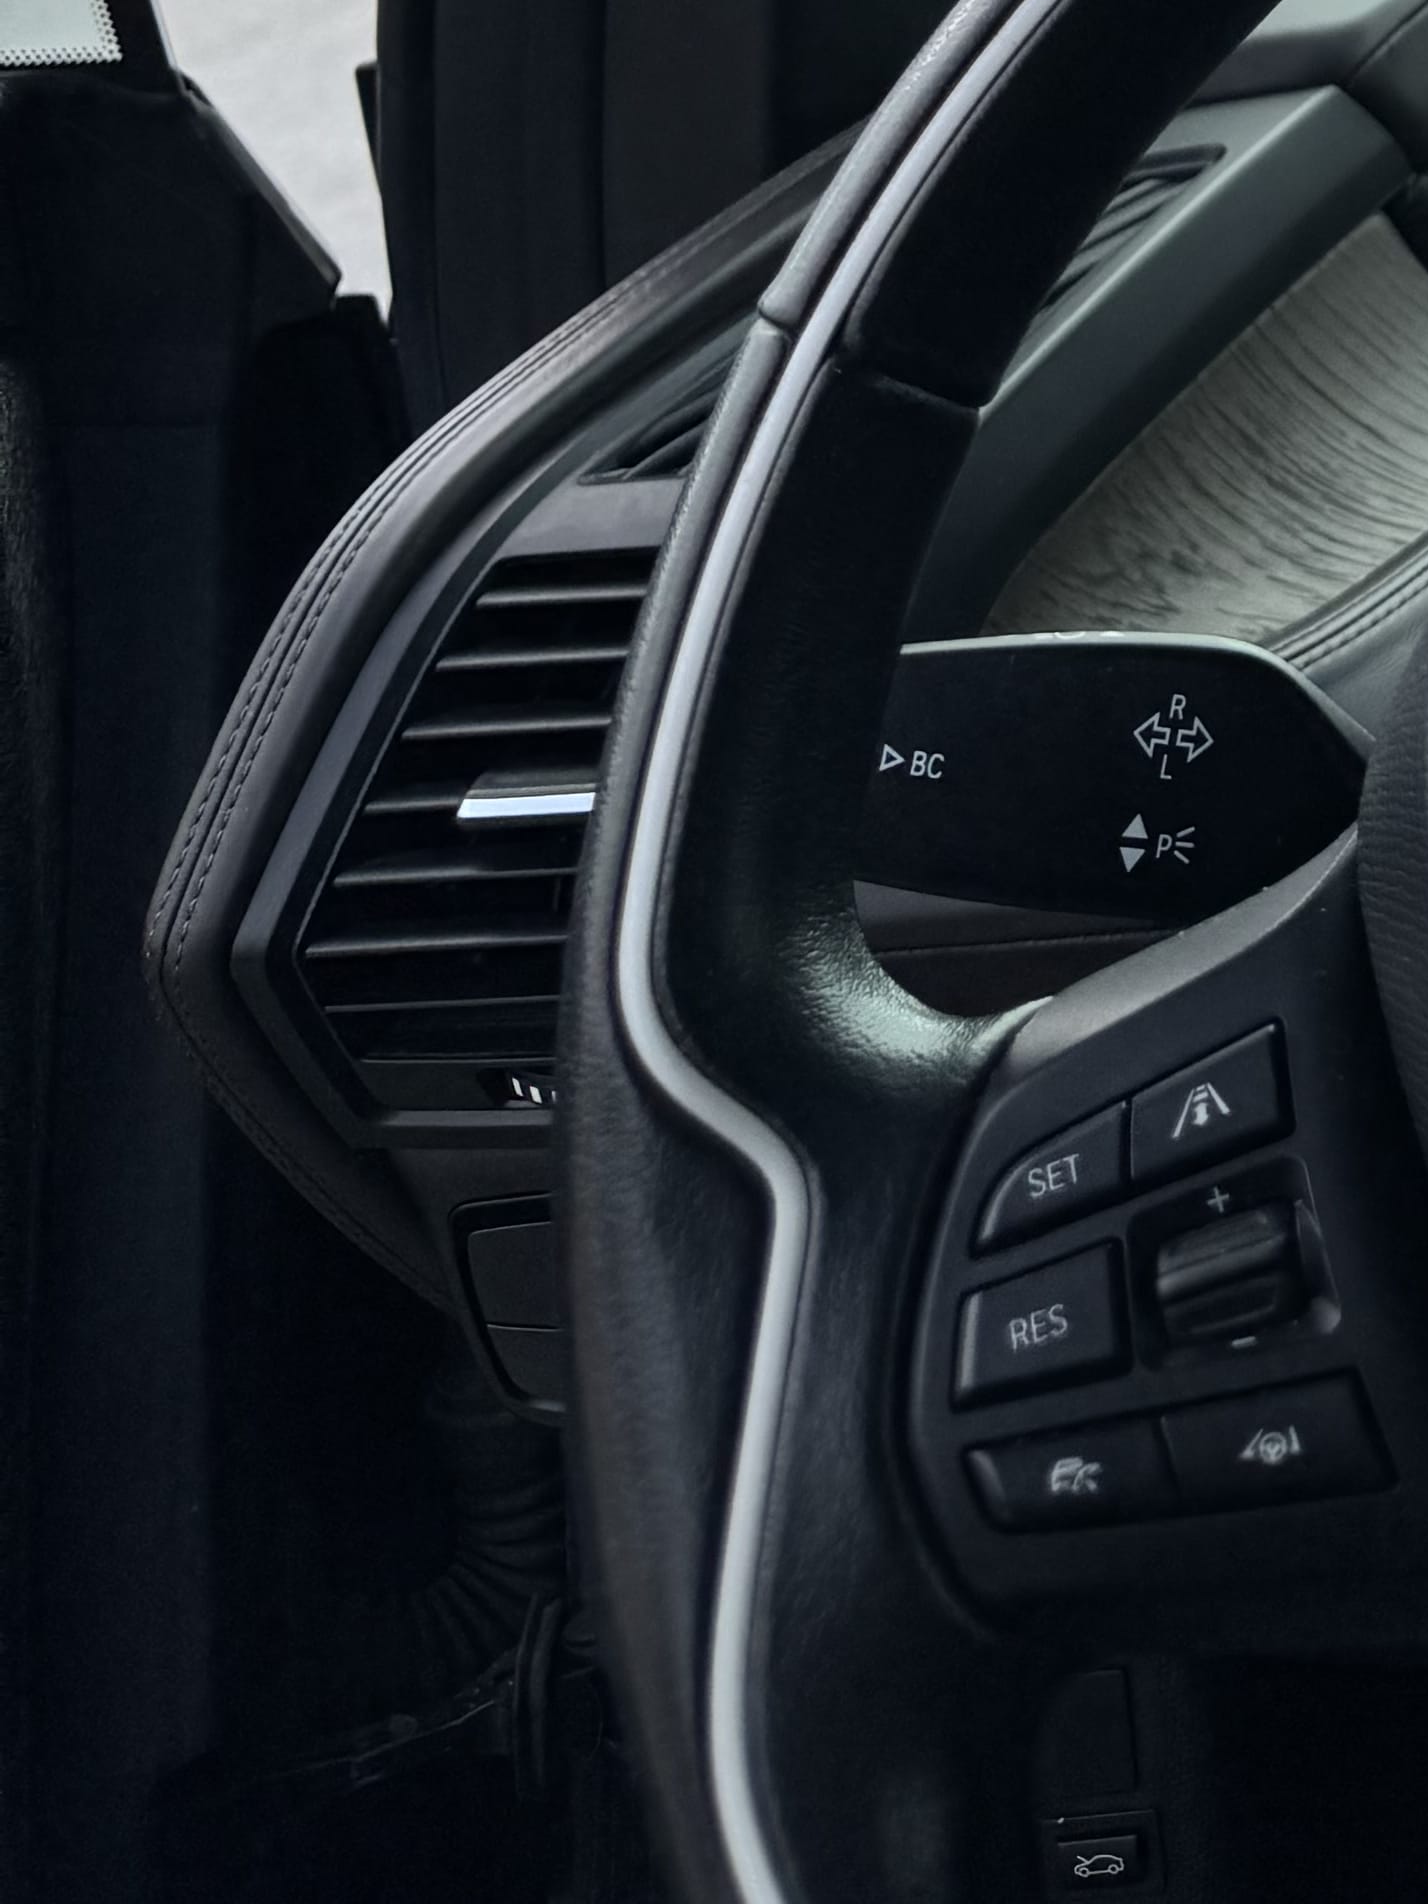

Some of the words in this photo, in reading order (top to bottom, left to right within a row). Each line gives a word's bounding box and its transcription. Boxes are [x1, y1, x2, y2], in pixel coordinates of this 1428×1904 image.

[1169, 694, 1187, 720] R
[910, 750, 945, 779] BC
[1160, 754, 1172, 780] L
[1156, 834, 1173, 859] P
[1028, 1153, 1080, 1198] SET
[1009, 1303, 1068, 1354] RES
